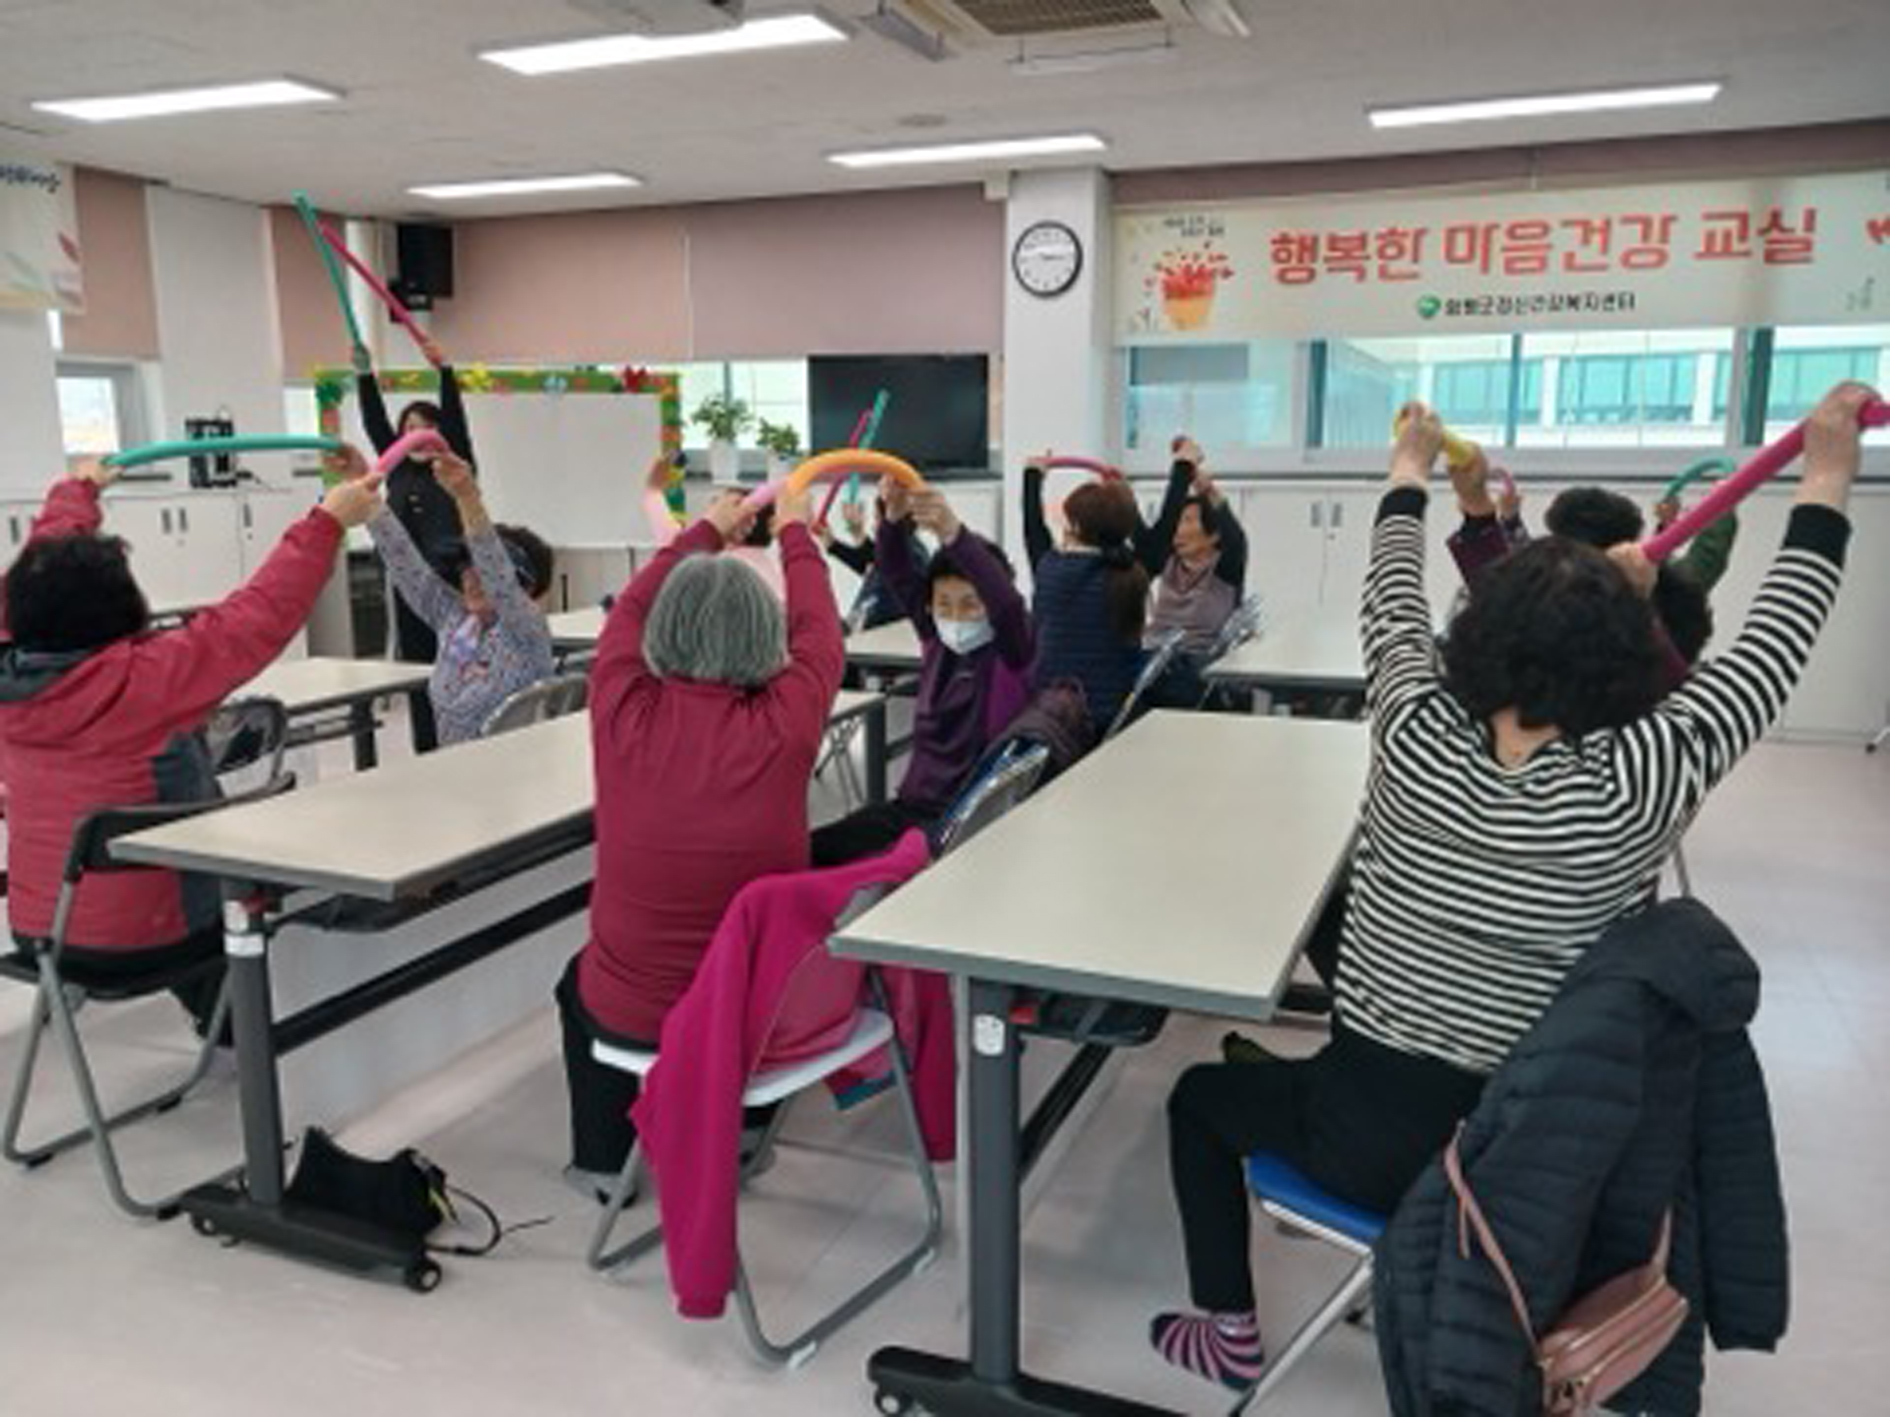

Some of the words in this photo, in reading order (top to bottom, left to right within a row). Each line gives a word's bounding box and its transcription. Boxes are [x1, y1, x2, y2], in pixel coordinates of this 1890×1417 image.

[1270, 227, 1428, 284] 행복한
[1443, 214, 1677, 275] 마음건강
[1693, 207, 1815, 265] 교실
